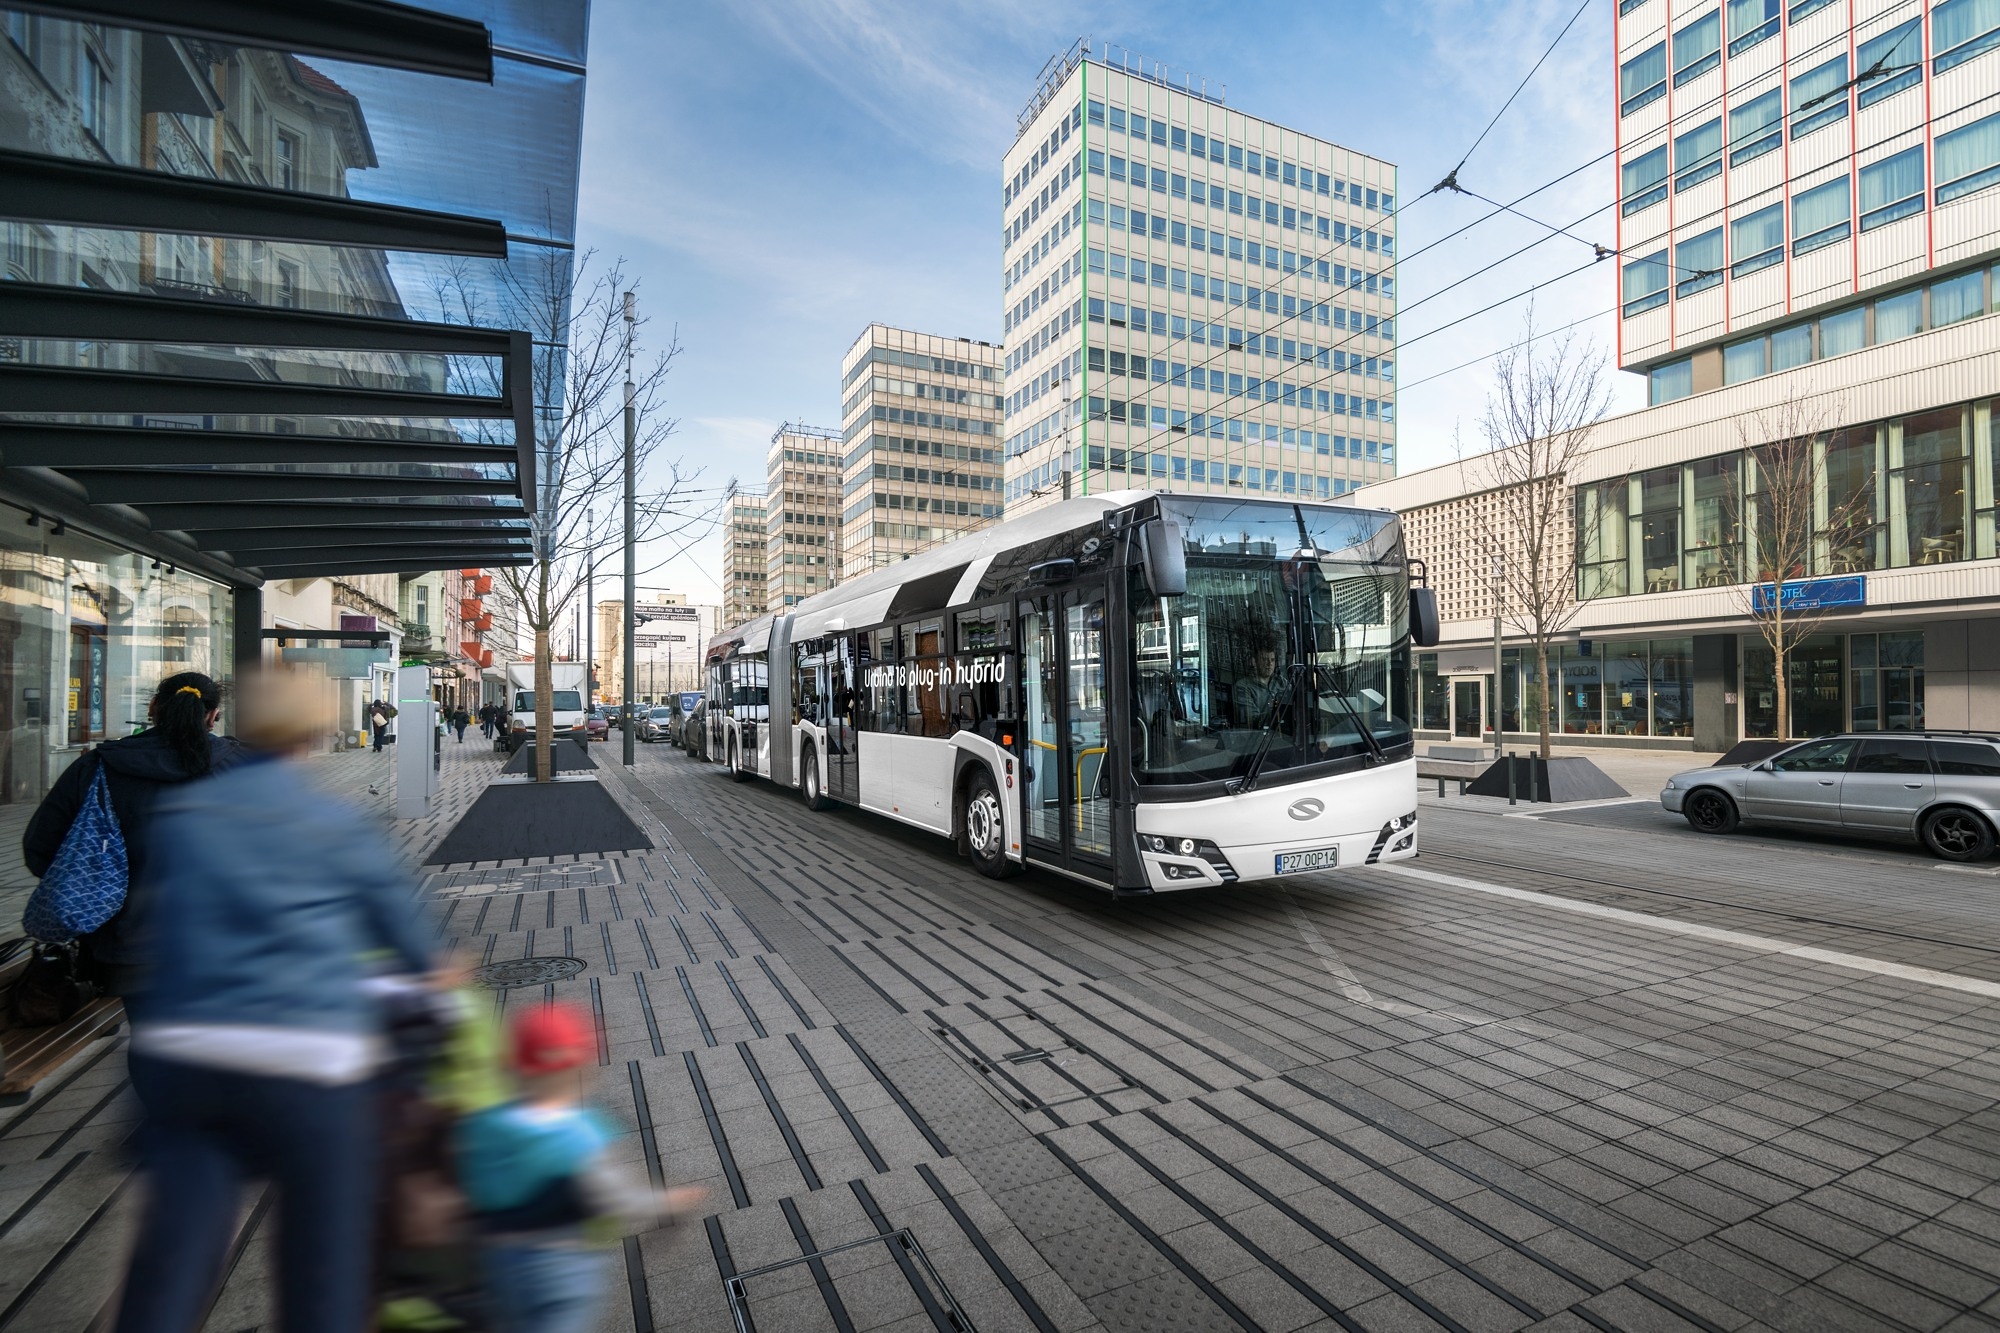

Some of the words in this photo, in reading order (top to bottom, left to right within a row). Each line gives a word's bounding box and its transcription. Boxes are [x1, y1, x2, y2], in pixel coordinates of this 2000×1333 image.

[1767, 588, 1806, 600] HOTEL
[864, 667, 894, 688] Urbino
[895, 666, 906, 687] 18
[908, 662, 951, 691] plug-in
[956, 656, 1005, 690] hybrid
